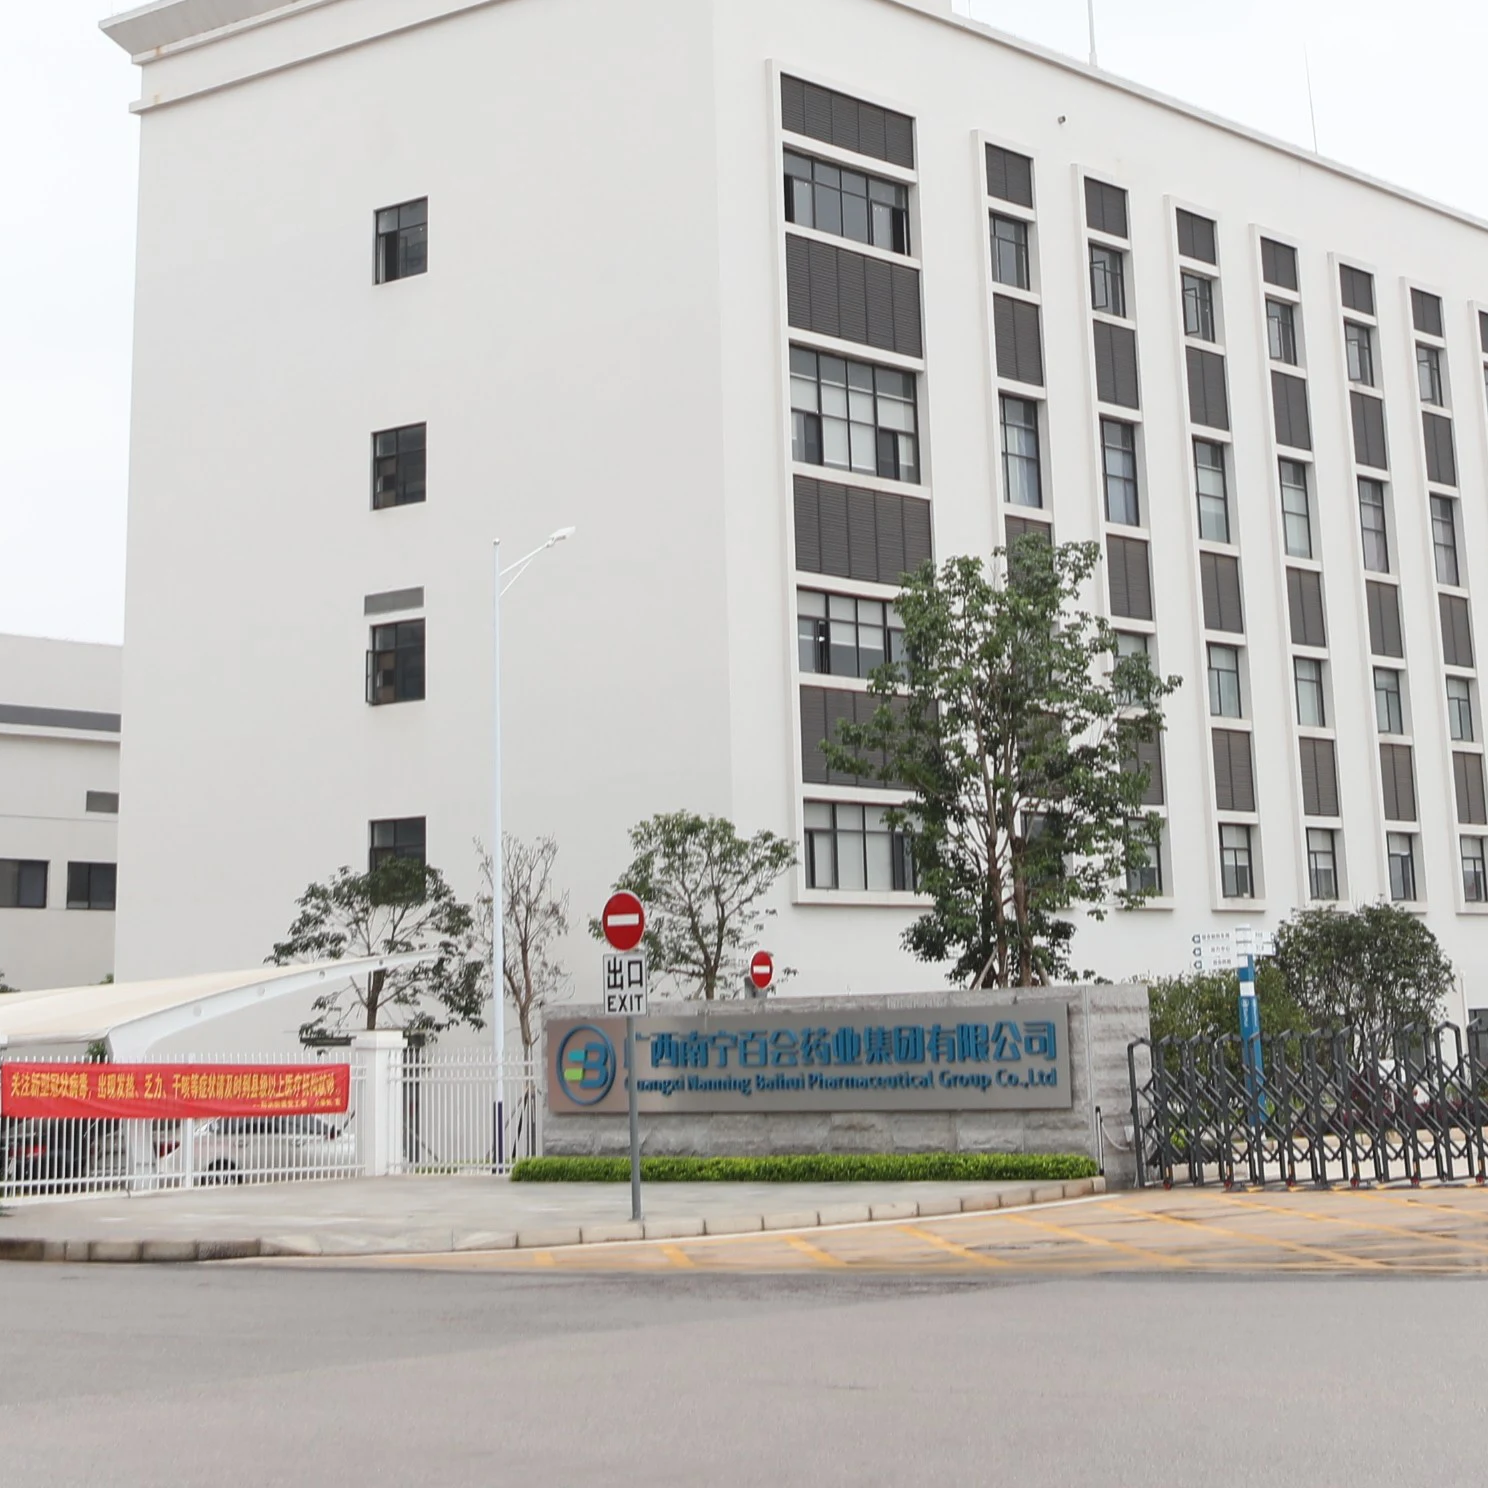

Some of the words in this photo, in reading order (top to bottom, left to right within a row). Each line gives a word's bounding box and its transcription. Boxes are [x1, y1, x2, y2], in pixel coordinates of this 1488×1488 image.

[607, 956, 643, 990] 出口
[607, 994, 643, 1012] EXIT
[687, 1074, 752, 1097] Nanning
[808, 1069, 934, 1090] Pharmaceutical
[939, 1069, 991, 1092] Group
